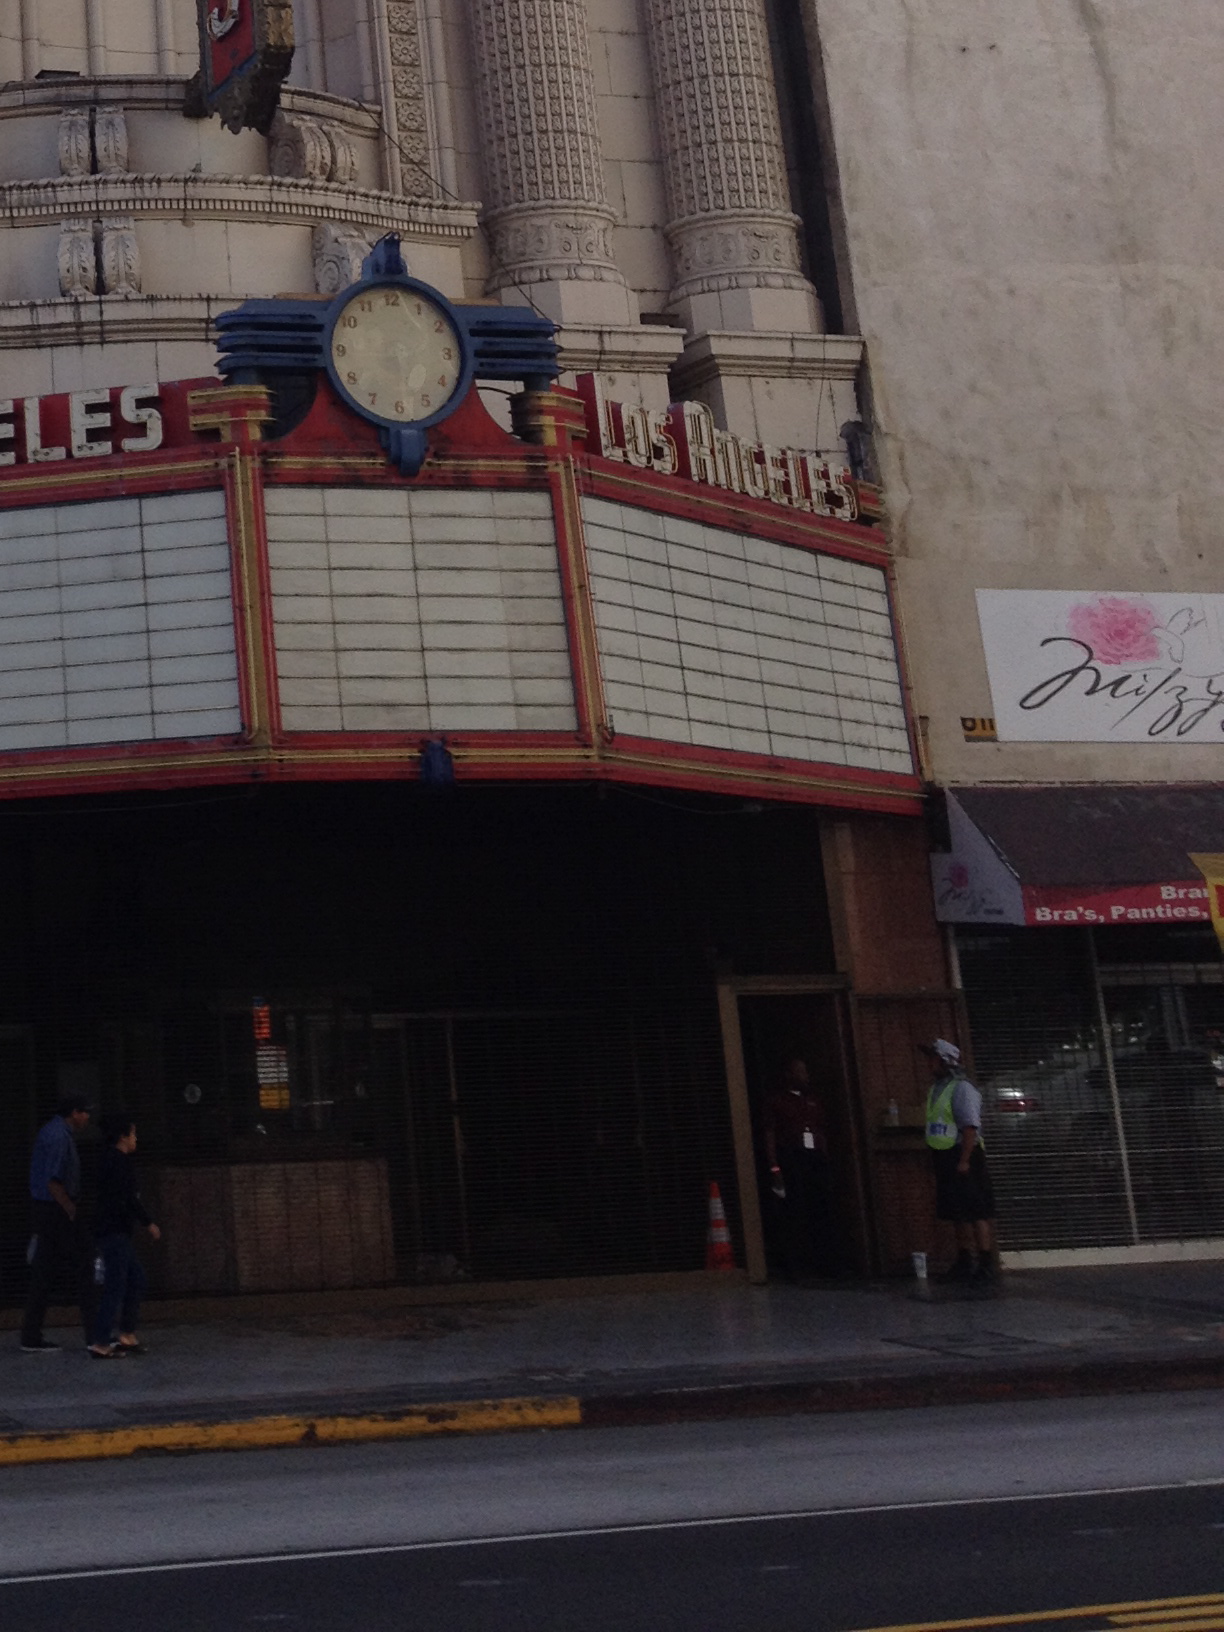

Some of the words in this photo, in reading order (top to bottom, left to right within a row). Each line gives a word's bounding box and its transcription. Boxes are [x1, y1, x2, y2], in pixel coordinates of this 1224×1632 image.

[358, 300, 372, 312] 11
[384, 294, 400, 307] 12
[414, 303, 422, 315] 1
[341, 315, 357, 329] 10
[434, 320, 444, 333] 2
[336, 344, 346, 357] 9
[442, 348, 452, 361] 3
[347, 371, 357, 385] 8
[437, 374, 447, 388] 4
[368, 393, 377, 405] 7
[421, 394, 431, 408] 5
[394, 400, 405, 414] 6
[594, 371, 678, 475] LOS
[1034, 905, 1104, 923] Bra's,
[1110, 903, 1208, 920] Panties,
